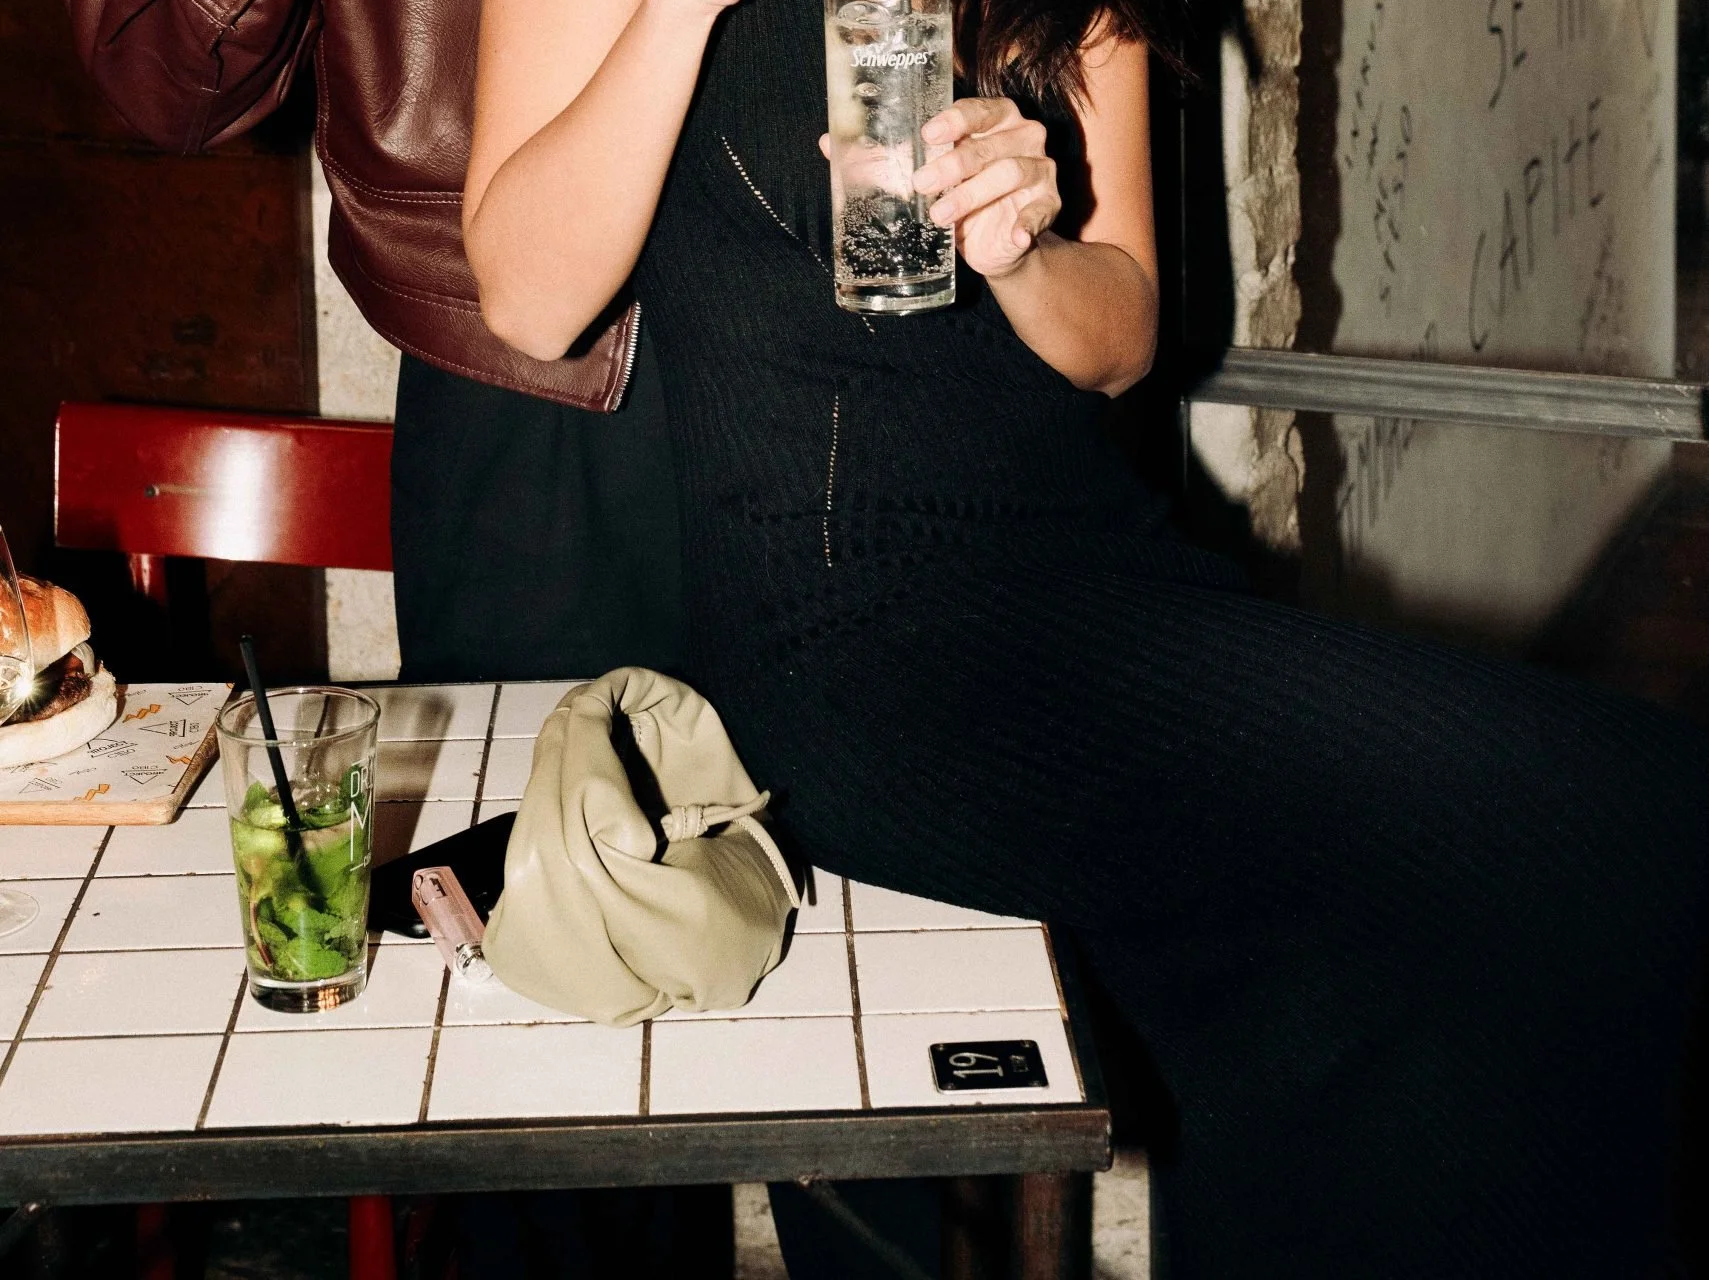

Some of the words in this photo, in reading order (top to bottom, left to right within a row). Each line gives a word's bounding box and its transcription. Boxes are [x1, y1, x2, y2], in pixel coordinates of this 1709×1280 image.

[850, 47, 929, 70] Schweppes
[1468, 98, 1606, 355] CAPITE
[948, 1052, 1004, 1078] 19
